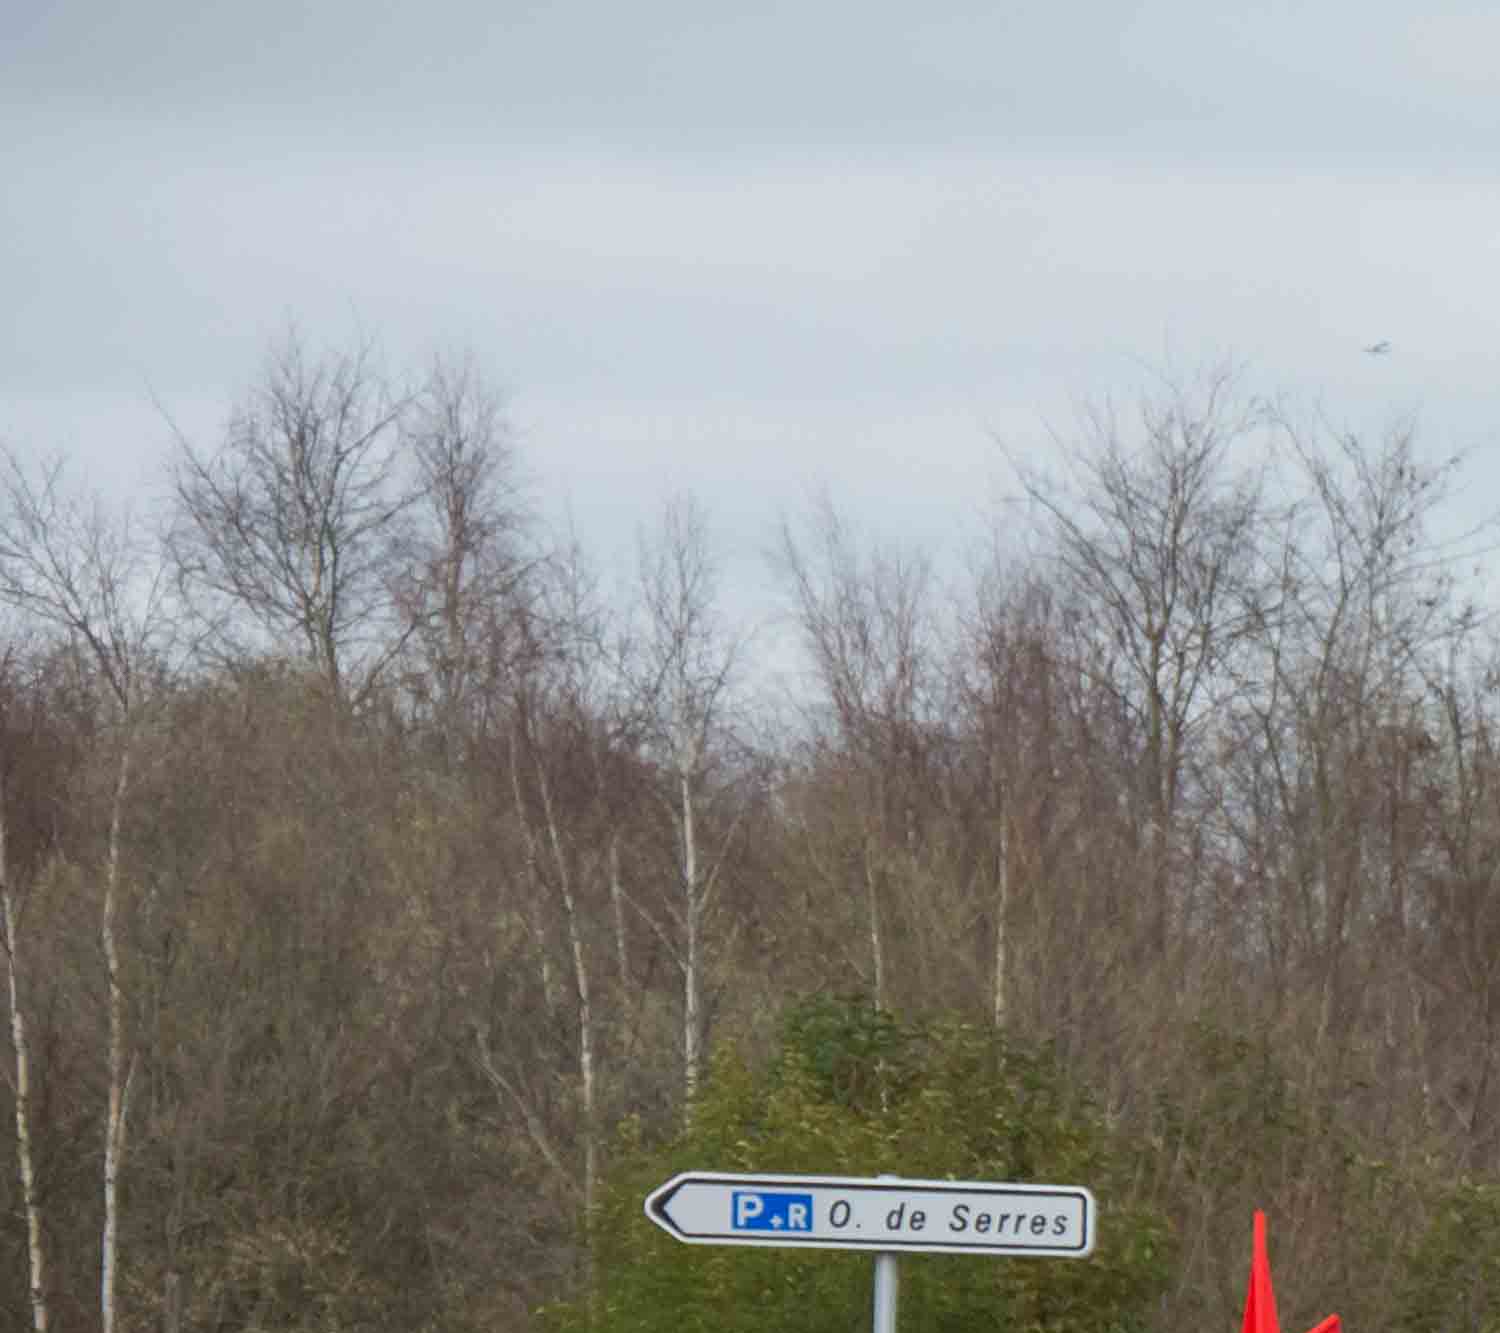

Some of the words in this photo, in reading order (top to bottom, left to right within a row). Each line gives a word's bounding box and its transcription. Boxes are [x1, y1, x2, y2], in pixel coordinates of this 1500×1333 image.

[828, 1200, 862, 1228] O.
[886, 1202, 927, 1231] de
[948, 1204, 1069, 1236] Serres
